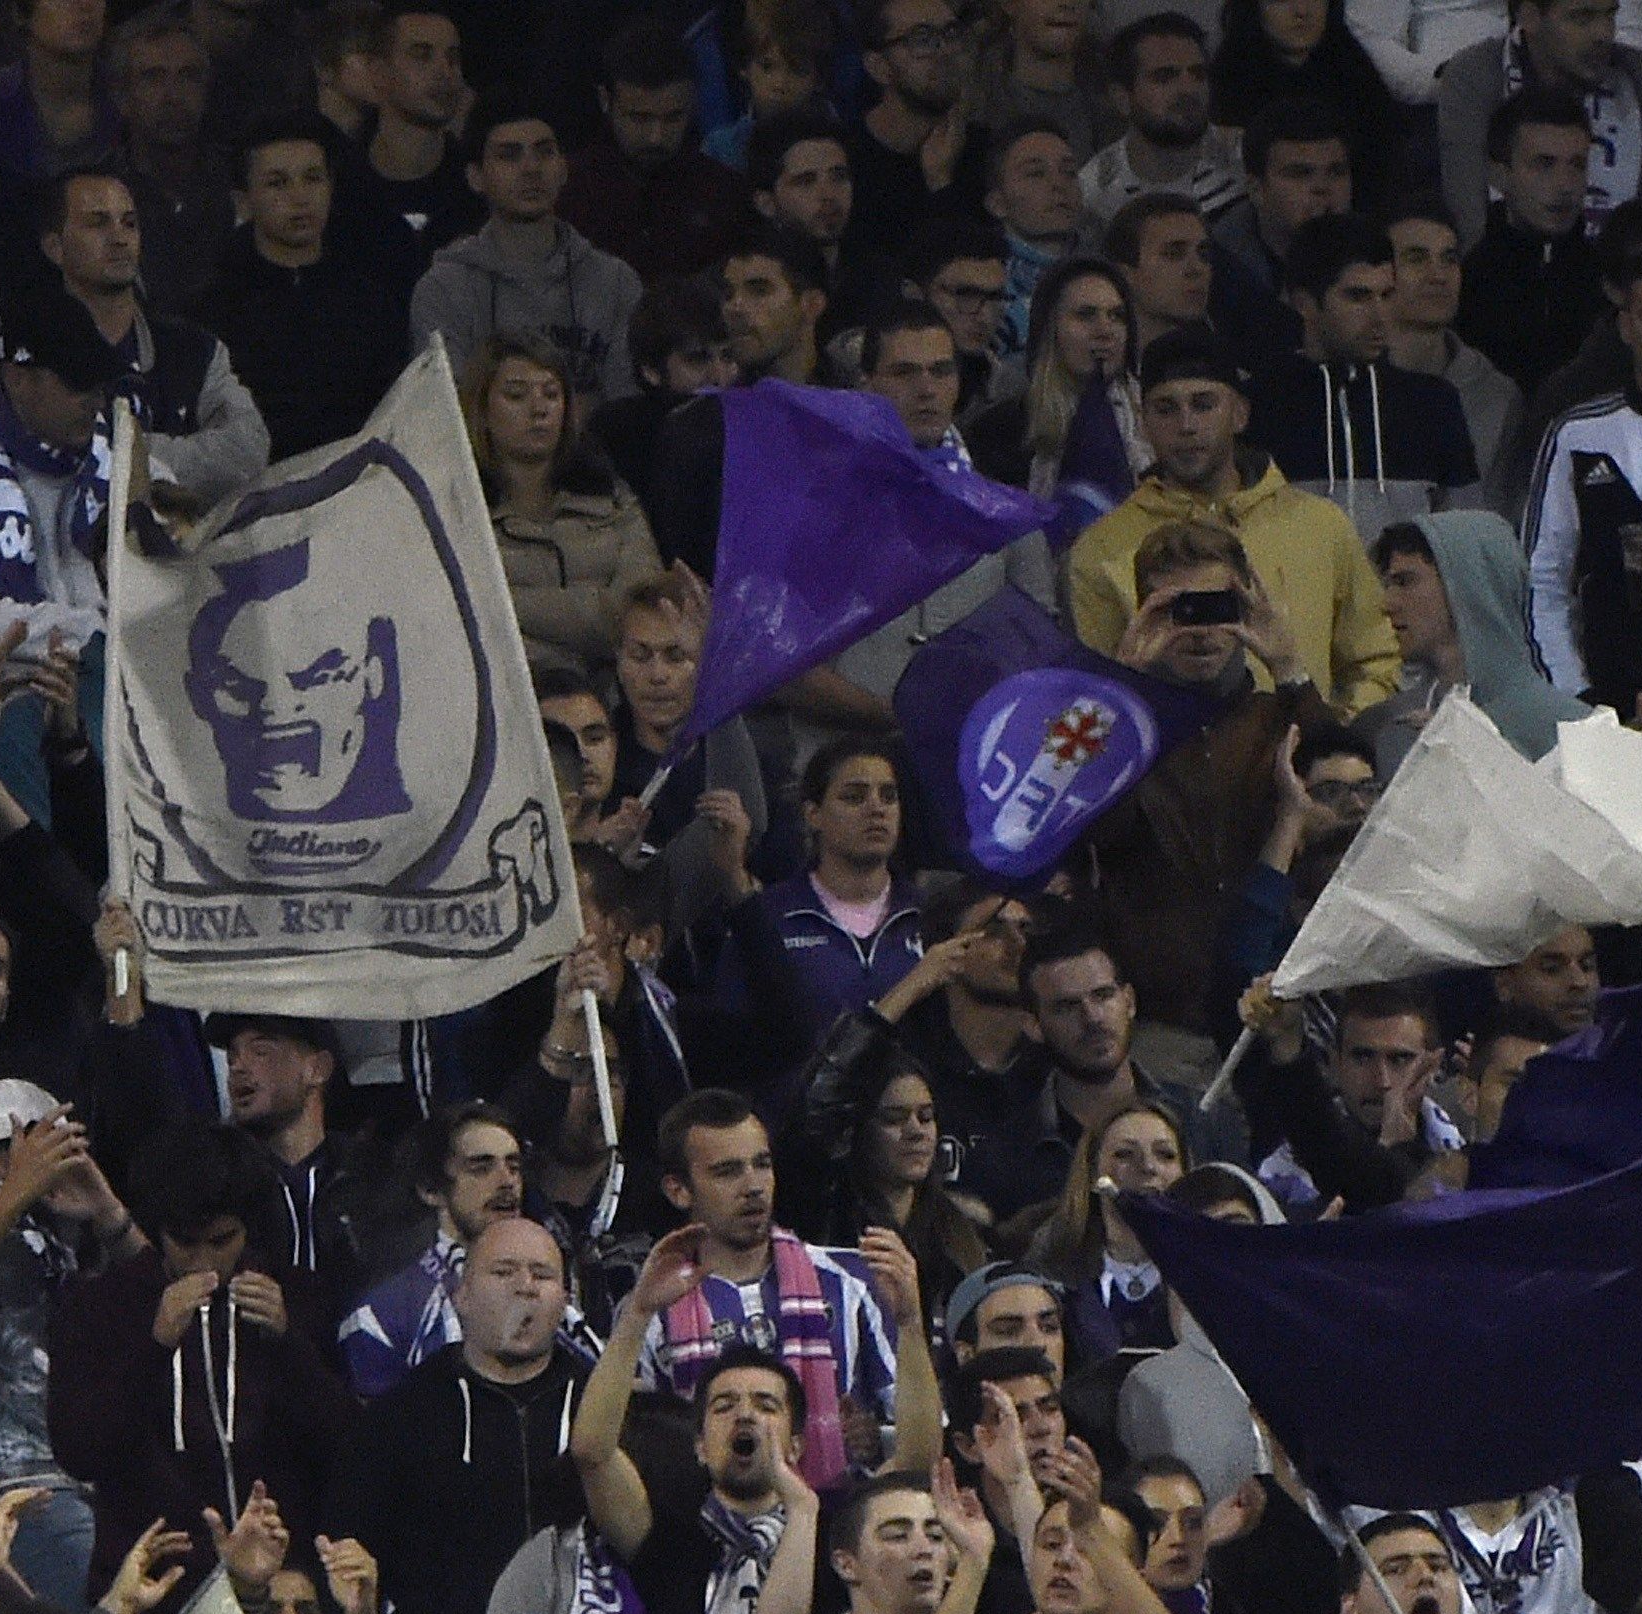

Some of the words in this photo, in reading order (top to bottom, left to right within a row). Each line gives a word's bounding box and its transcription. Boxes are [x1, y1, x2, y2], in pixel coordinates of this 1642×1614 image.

[142, 899, 258, 943] CURVA
[279, 899, 353, 936] EST
[379, 901, 506, 939] TOLOSA
